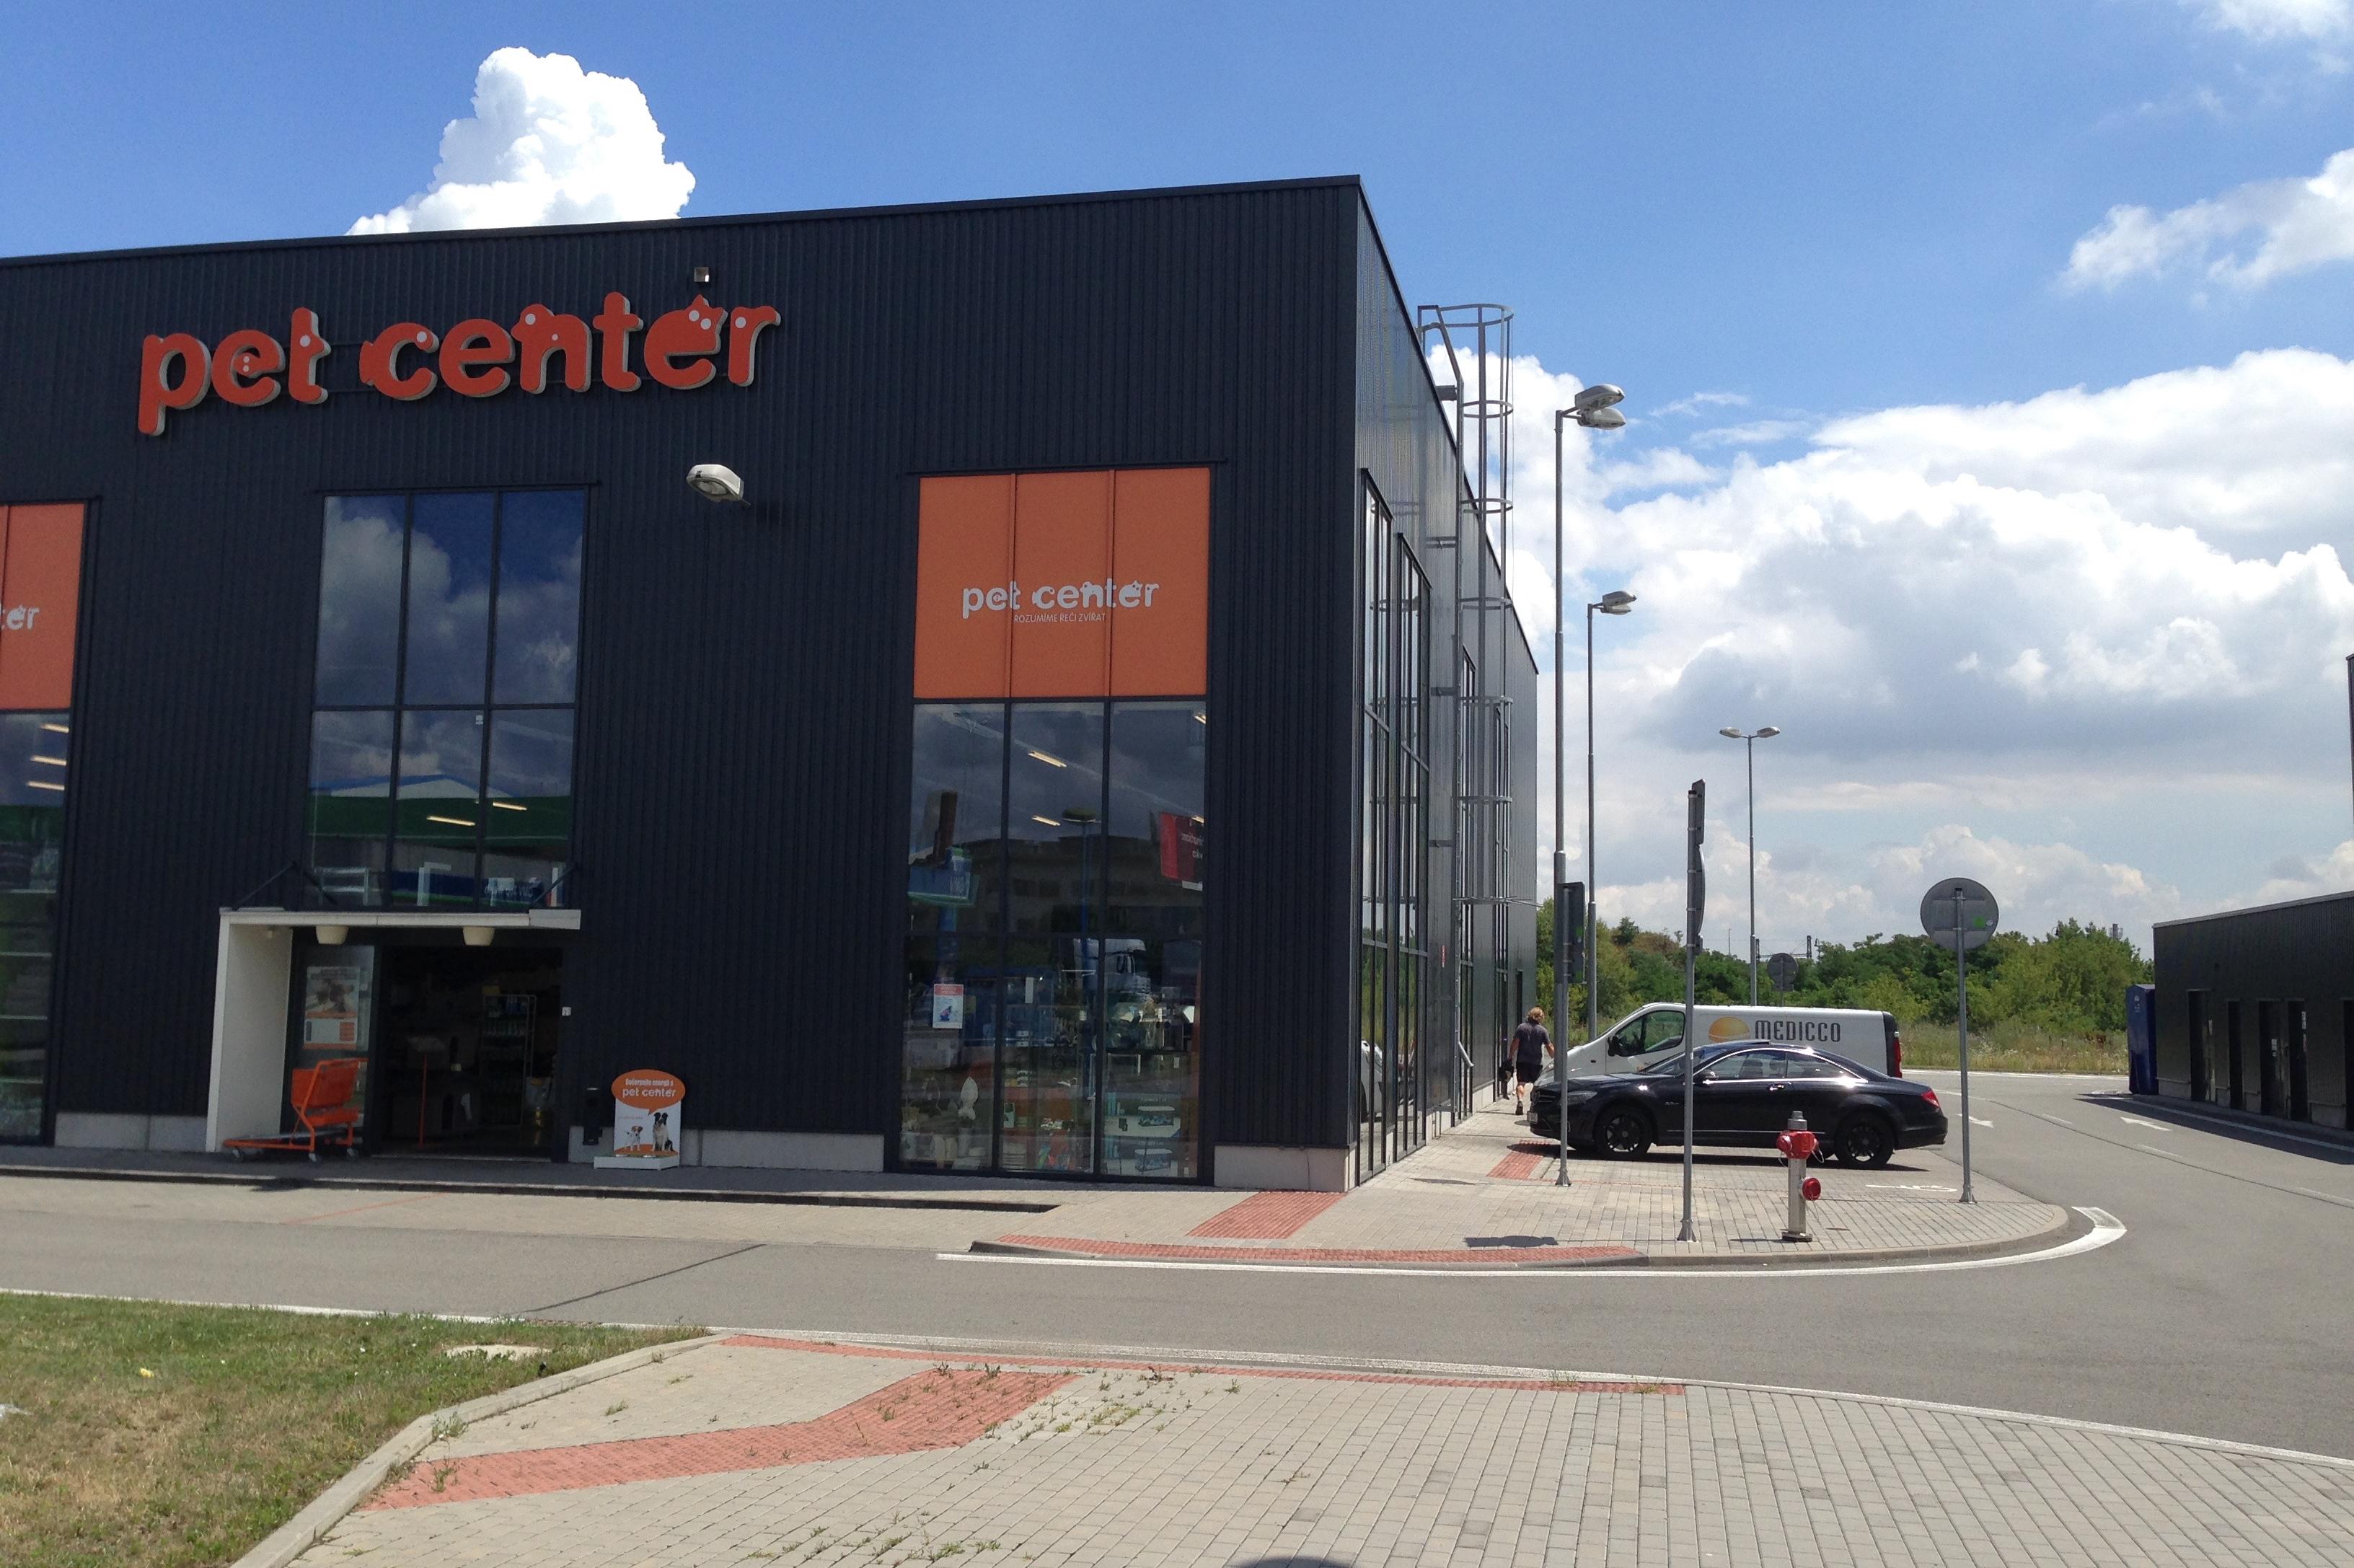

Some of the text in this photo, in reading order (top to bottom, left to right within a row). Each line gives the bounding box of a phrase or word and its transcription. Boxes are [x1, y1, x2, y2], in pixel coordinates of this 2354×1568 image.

[138, 291, 781, 436] pet center
[962, 578, 1160, 619] pet center
[1014, 613, 1058, 624] ROZUMÍME
[1755, 1020, 1841, 1042] MEDICCO
[622, 1088, 676, 1098] pet center
